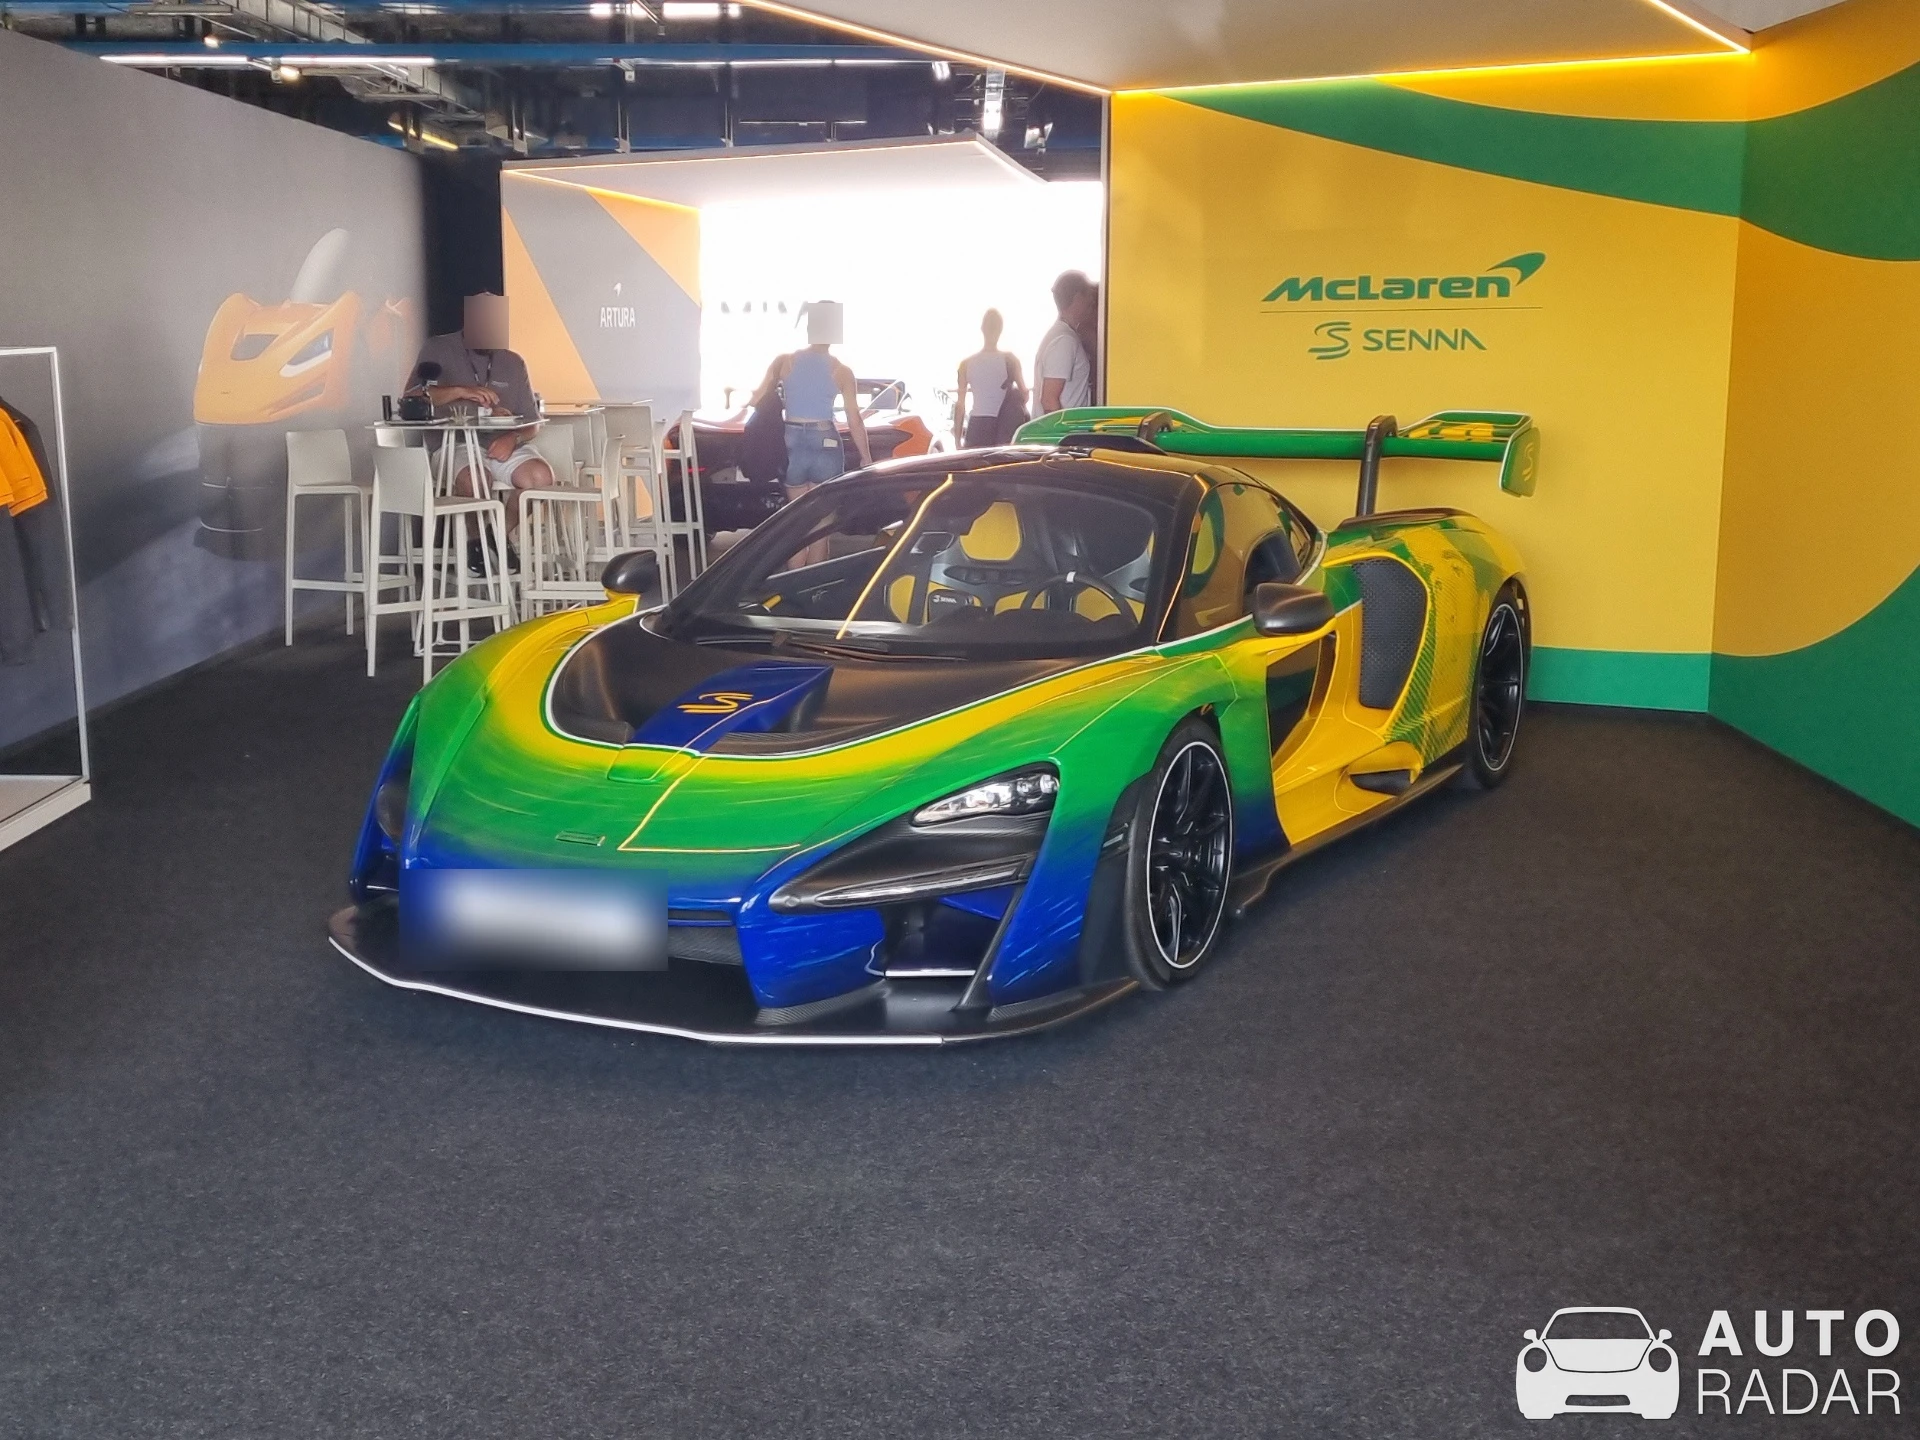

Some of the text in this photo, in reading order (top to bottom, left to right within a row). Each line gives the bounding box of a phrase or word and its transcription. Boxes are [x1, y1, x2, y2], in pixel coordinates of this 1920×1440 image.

[1261, 275, 1511, 302] McLaren
[600, 307, 635, 327] ARTURA
[1363, 328, 1487, 351] SENNA
